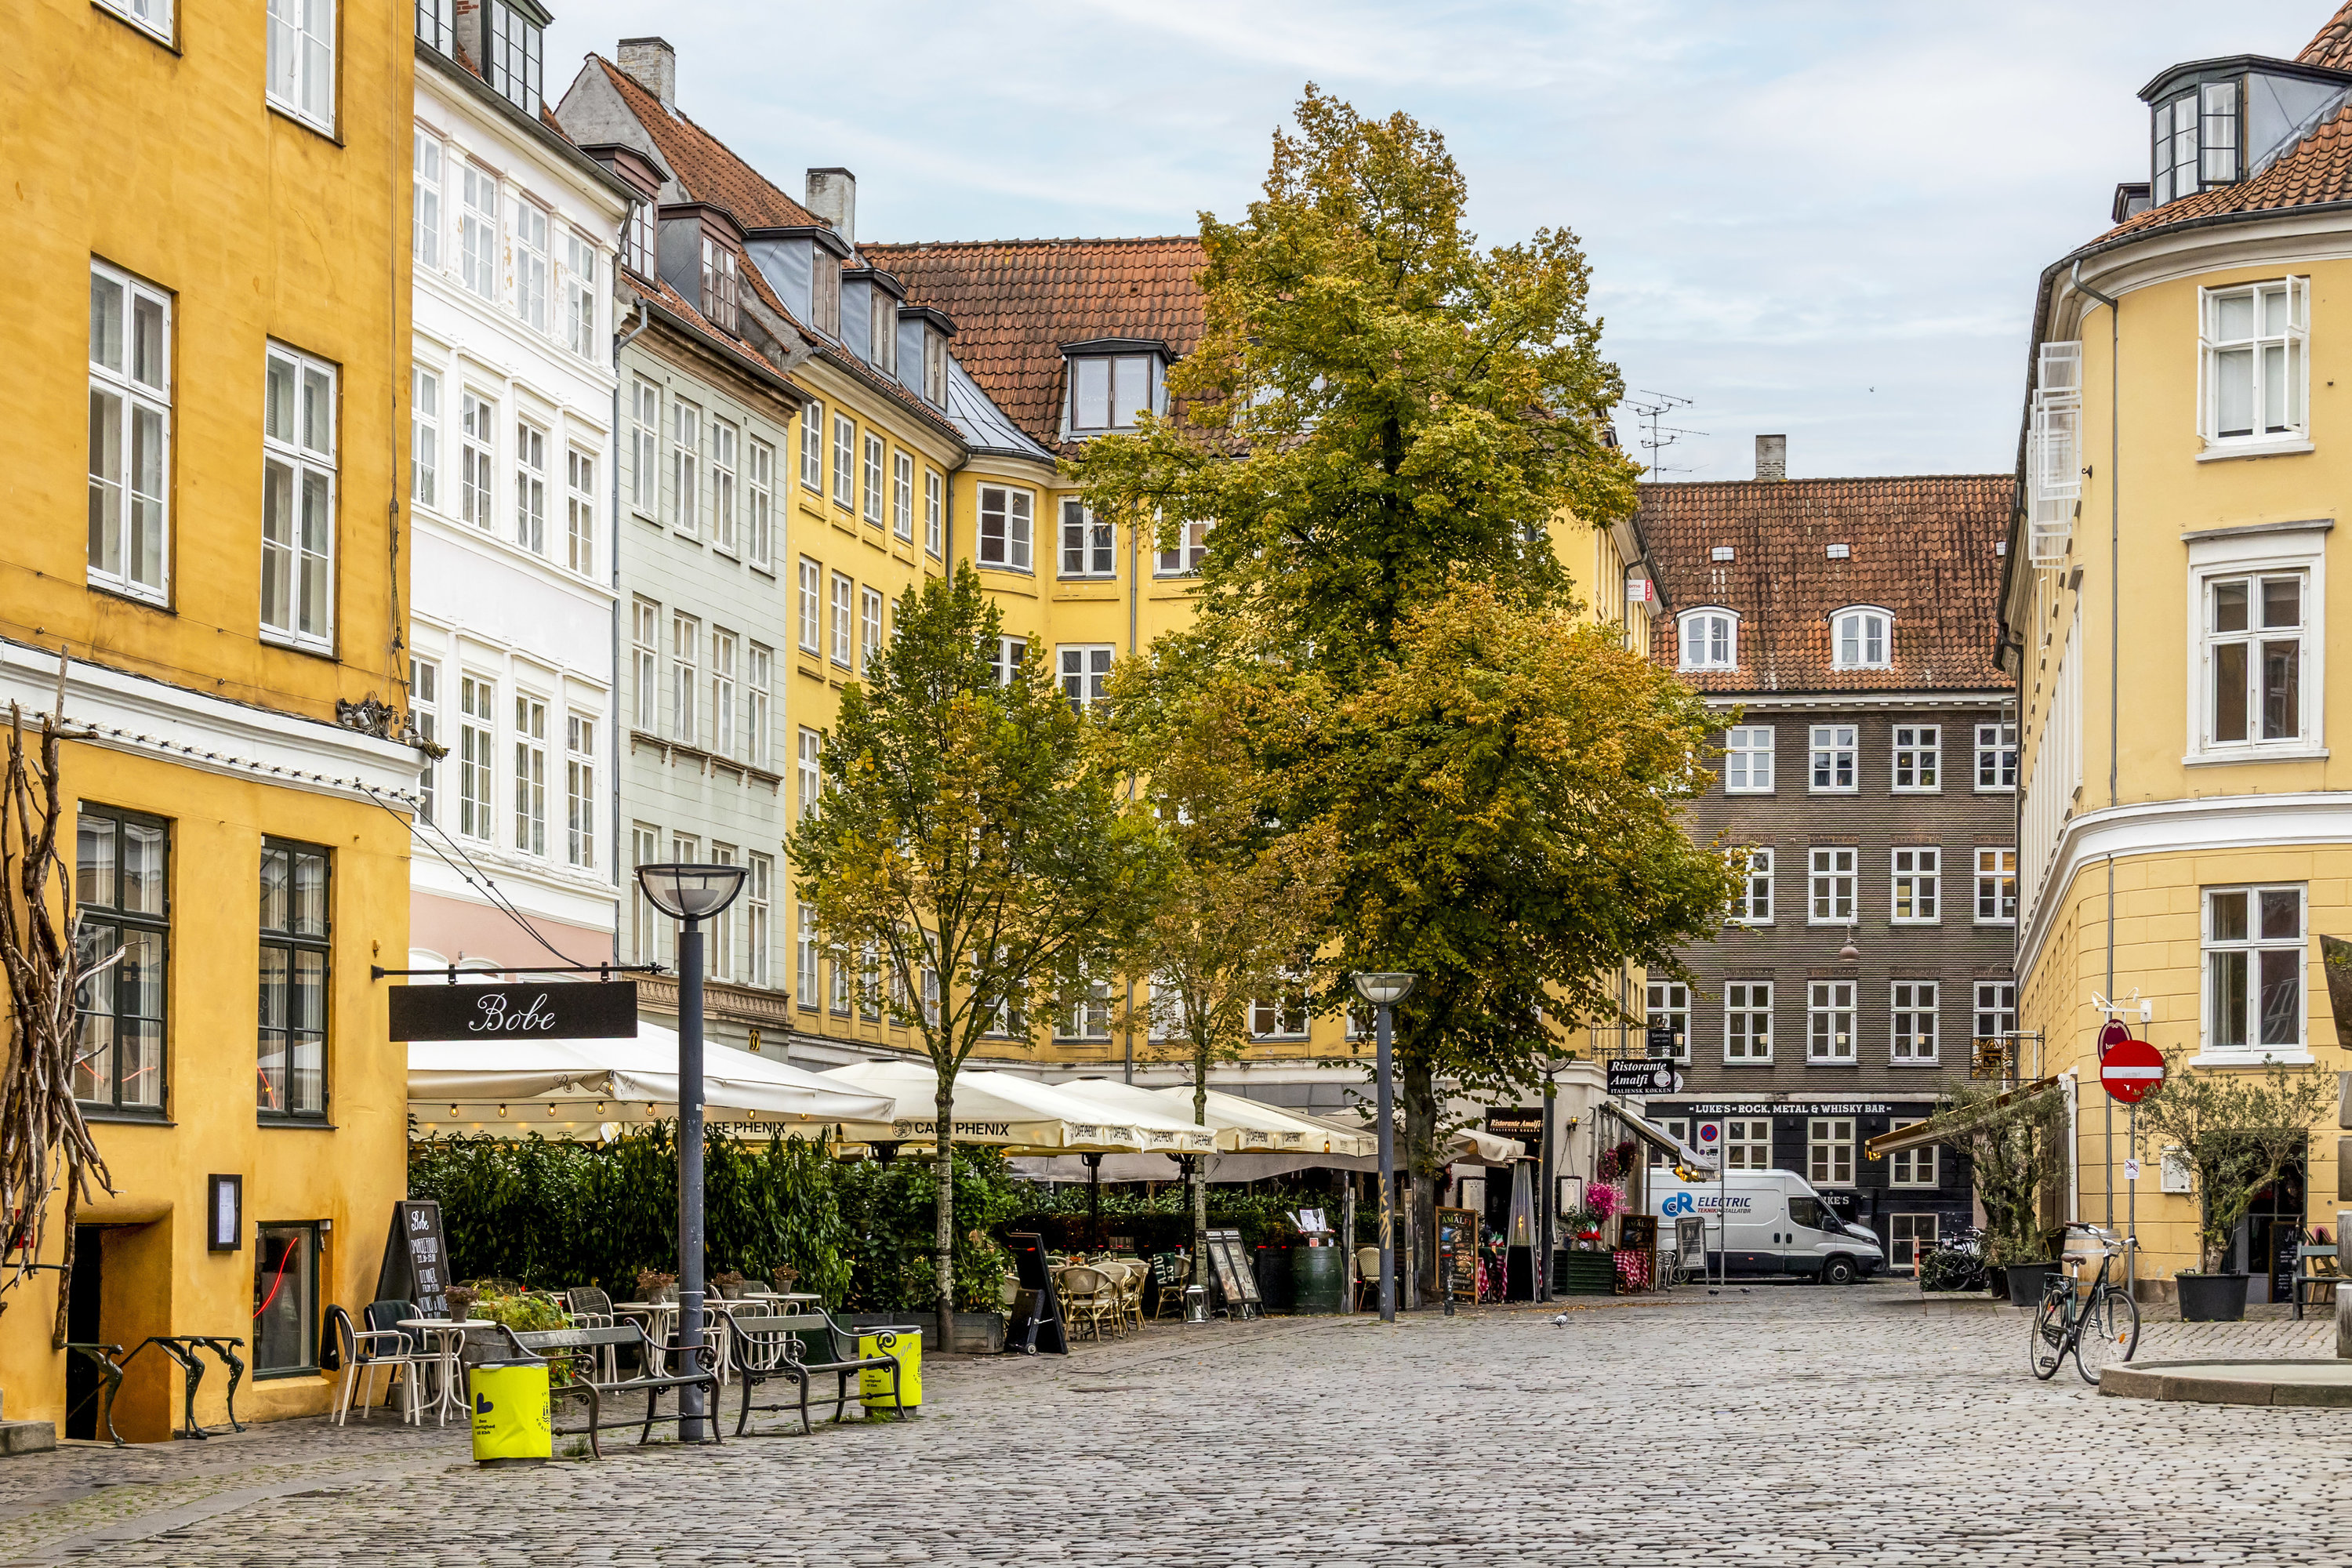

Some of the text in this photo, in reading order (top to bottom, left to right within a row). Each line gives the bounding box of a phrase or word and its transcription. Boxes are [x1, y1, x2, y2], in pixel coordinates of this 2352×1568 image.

[469, 993, 555, 1031] Bobe
[1610, 1062, 1667, 1071] Ristorante
[1610, 1075, 1648, 1087] Amalfi
[1738, 1105, 1770, 1113] ROCK,
[1865, 1104, 1886, 1112] BAR
[734, 1121, 786, 1134] PHENIX
[956, 1122, 1010, 1137] PHENIX
[1520, 1120, 1541, 1128] Amalfi
[1697, 1197, 1751, 1207] ELECTRIC
[411, 1210, 430, 1232] Bobe
[1442, 1216, 1472, 1226] AMALFI
